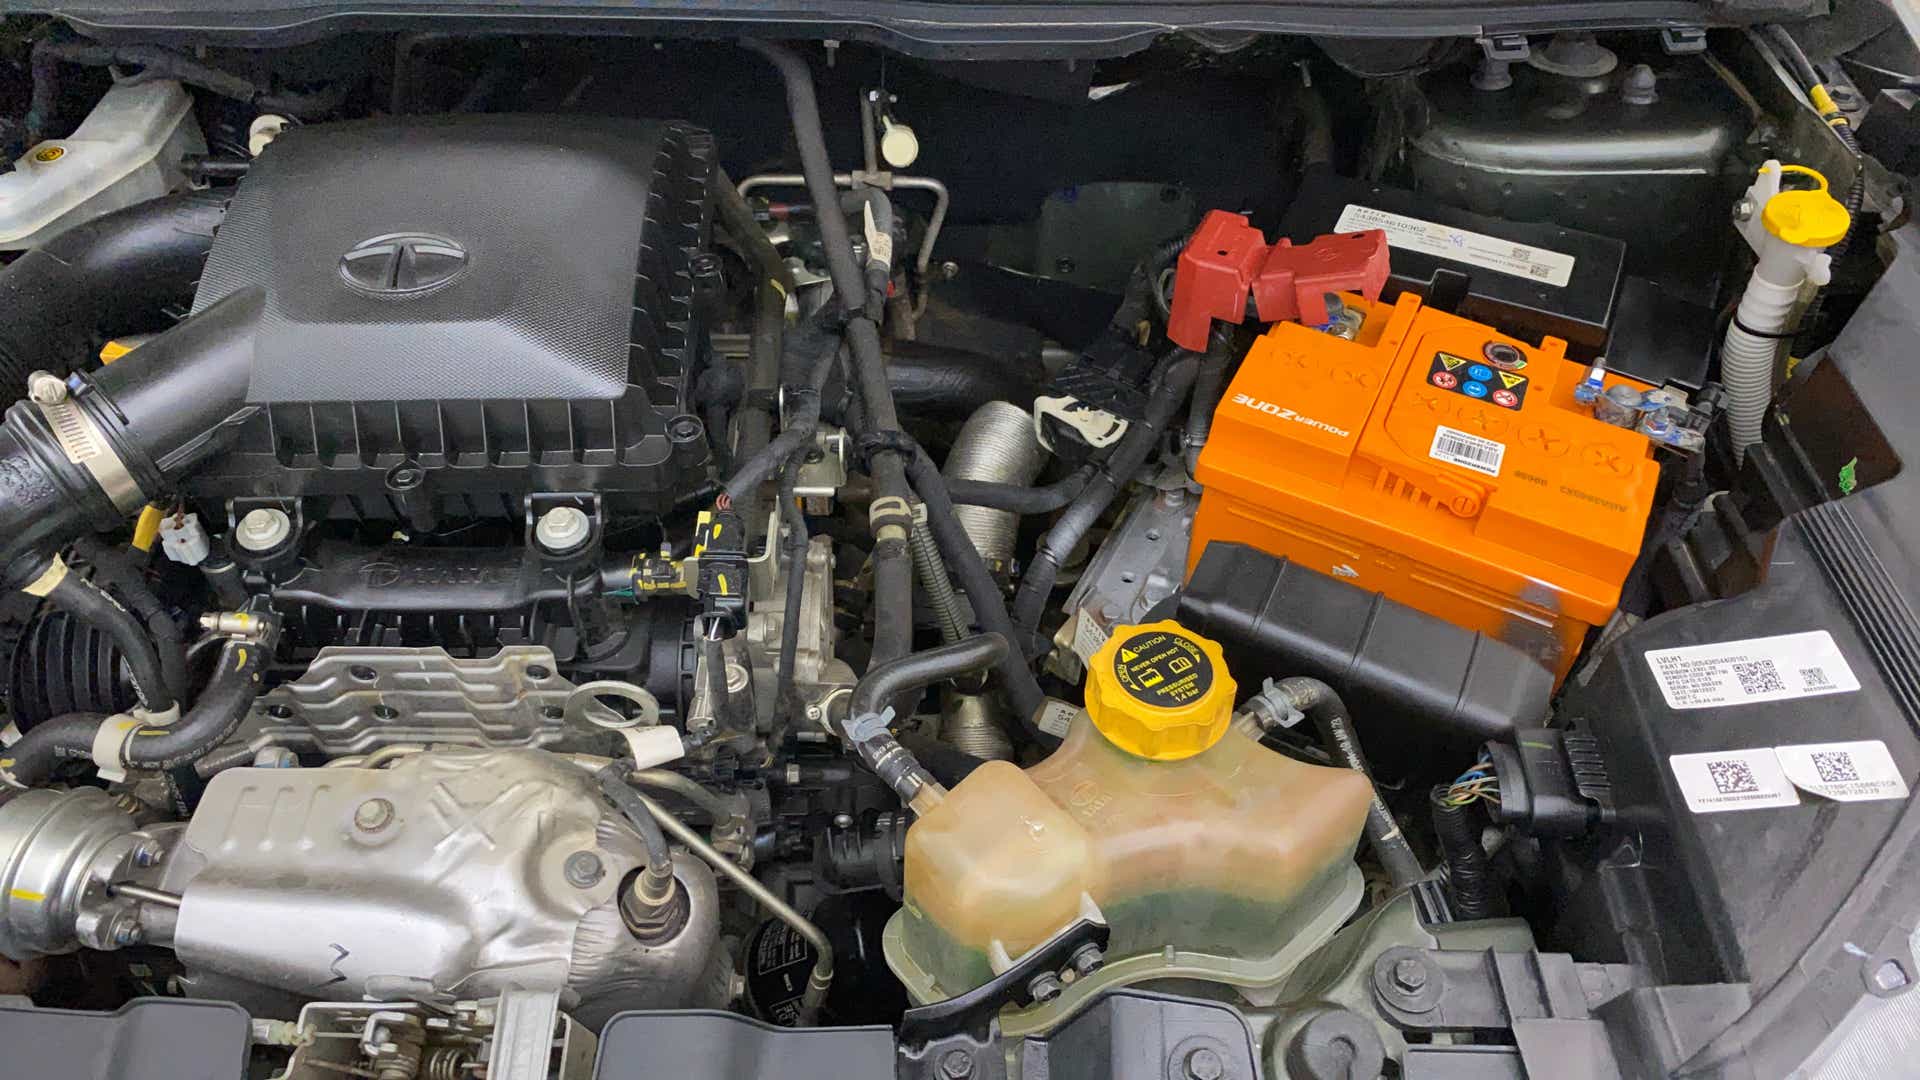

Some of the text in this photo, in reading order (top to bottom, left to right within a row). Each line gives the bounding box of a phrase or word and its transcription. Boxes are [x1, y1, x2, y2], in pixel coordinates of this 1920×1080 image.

[1231, 393, 1350, 438] POWERZONE
[1133, 635, 1167, 653] CAUTION
[1173, 637, 1200, 655] CLOSE
[1131, 647, 1179, 672] NEVER OPEN HOT
[1169, 681, 1195, 697] SYSTEM
[1187, 688, 1200, 698] bar
